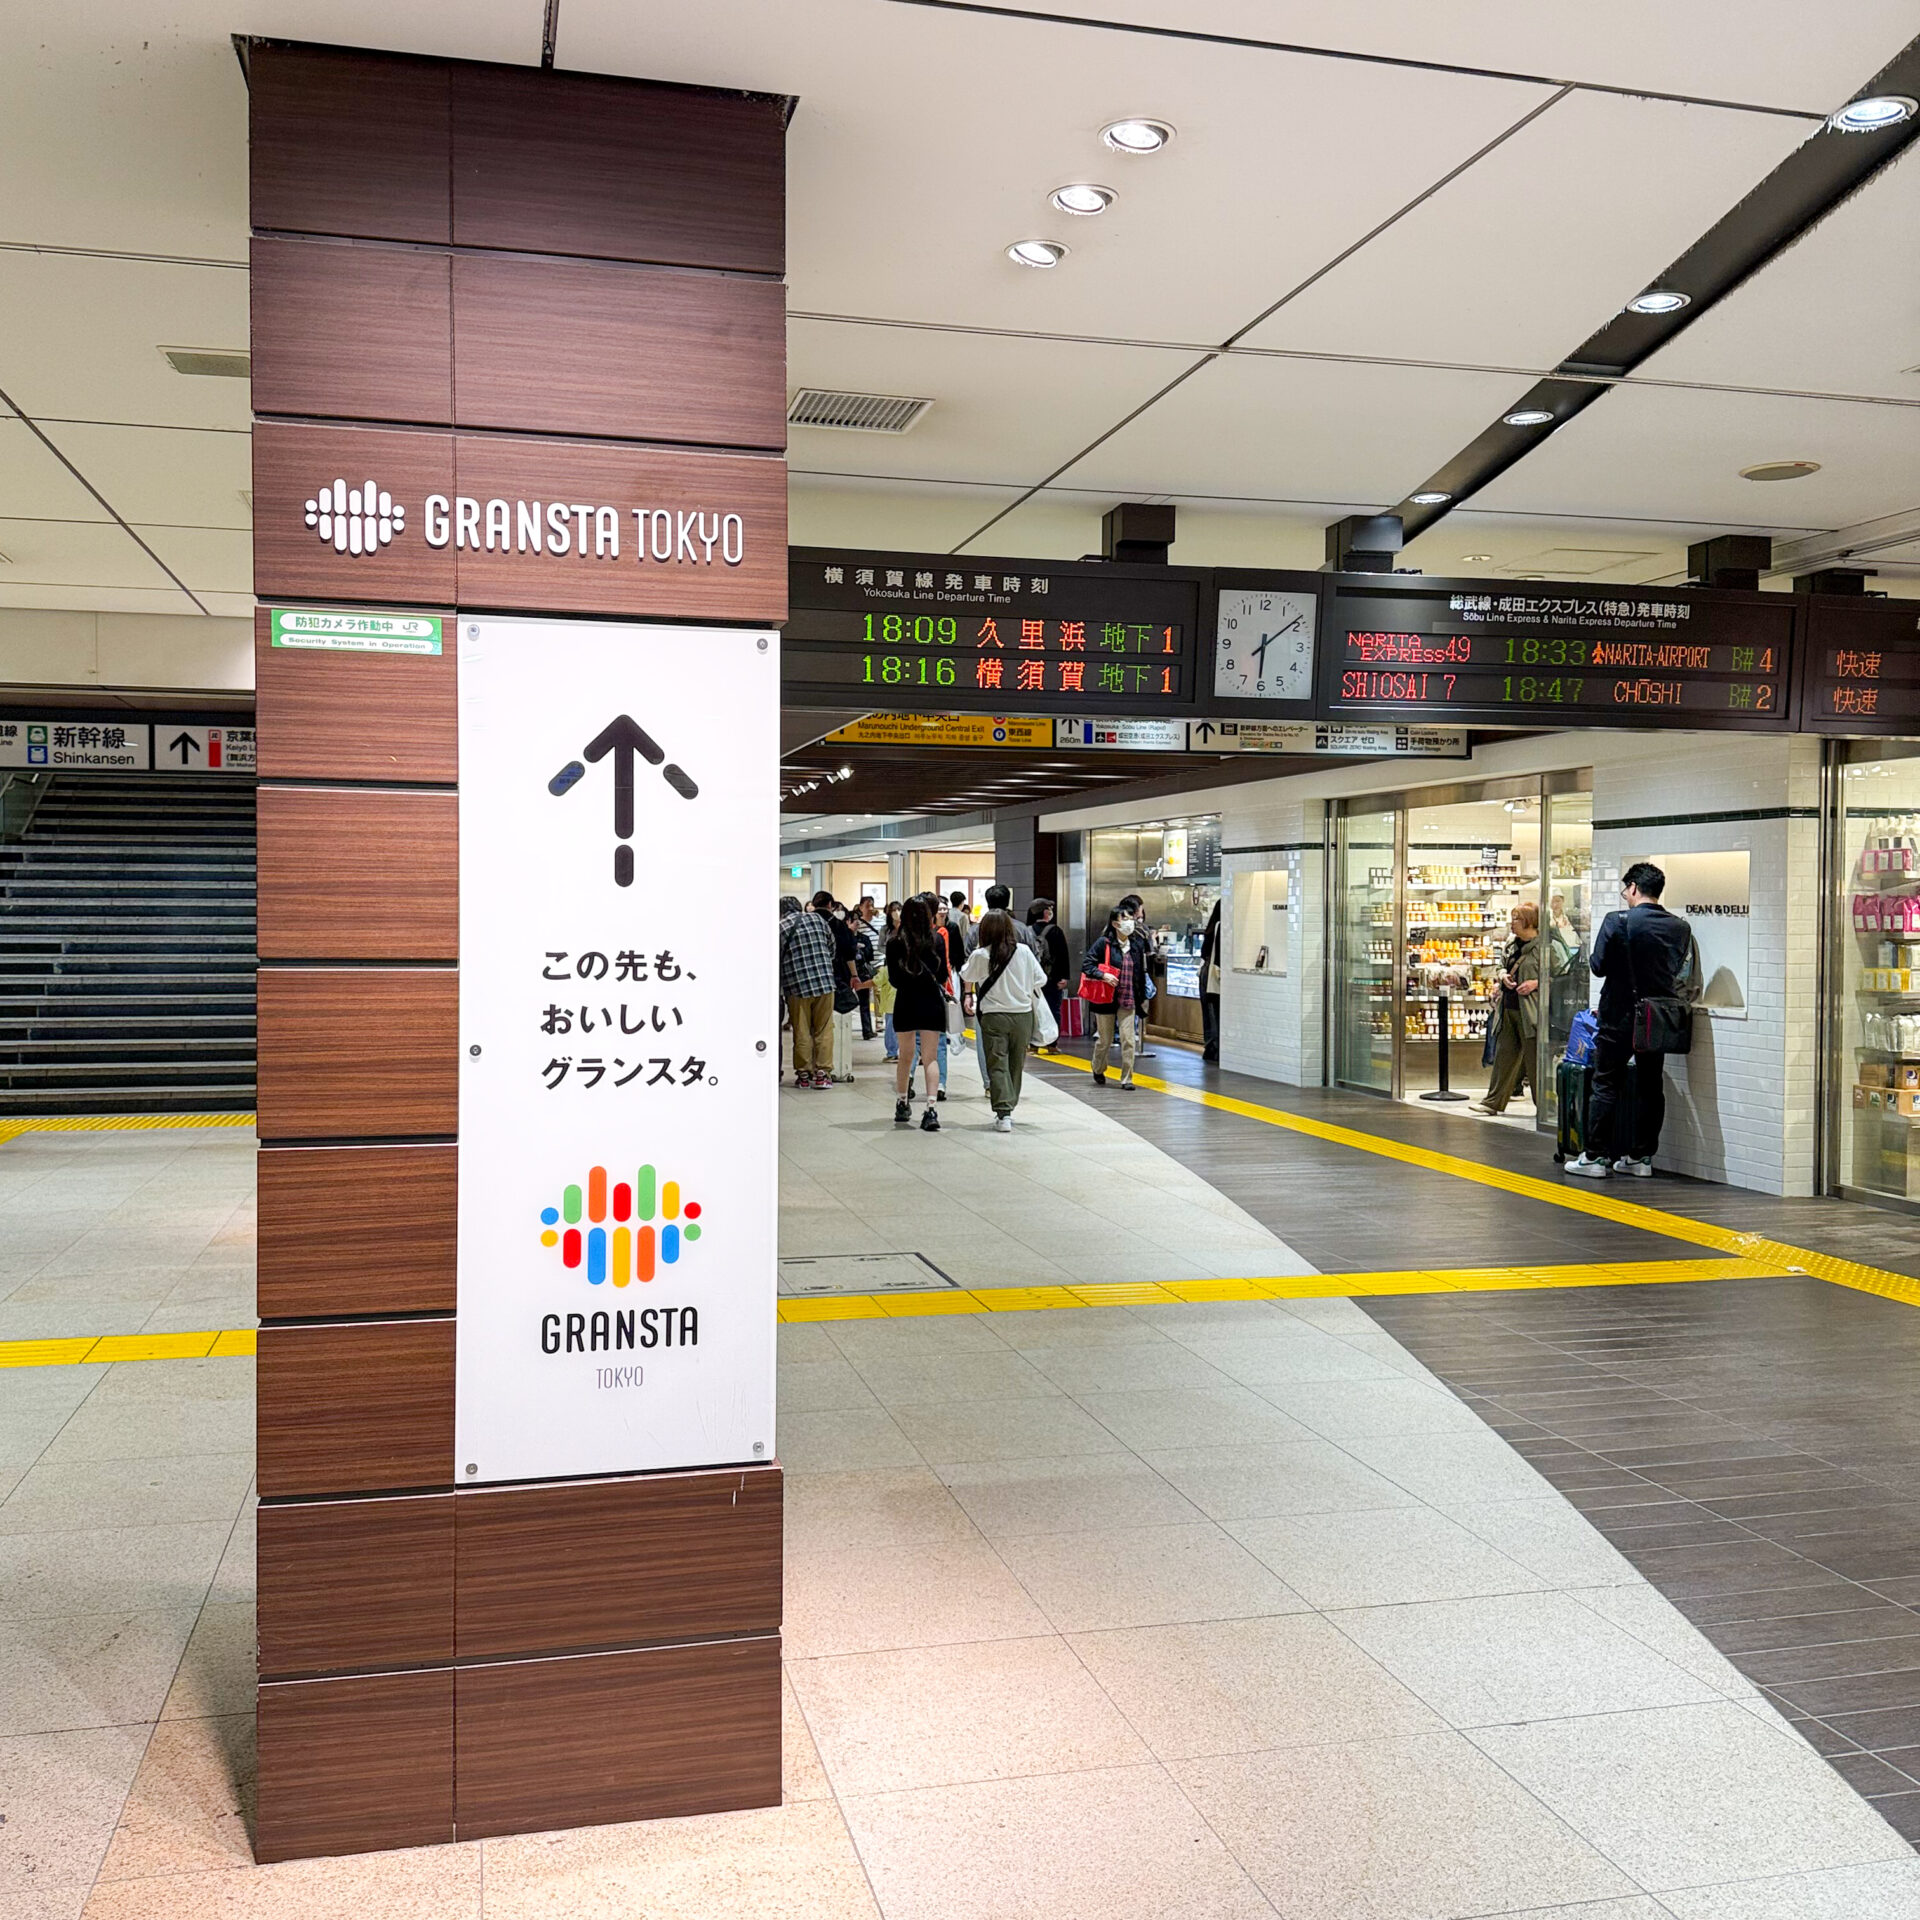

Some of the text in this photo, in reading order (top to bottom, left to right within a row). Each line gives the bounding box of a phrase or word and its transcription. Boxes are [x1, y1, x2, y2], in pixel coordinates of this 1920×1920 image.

[424, 494, 744, 564] GRANSTA TOKYO
[824, 566, 1049, 594] 横須賀線発車時刻
[863, 587, 1011, 604] Yokosuka Line Departure Time
[1243, 604, 1252, 615] 11
[1260, 599, 1272, 611] 12
[295, 616, 419, 632] 防犯カメラ作動中 JR
[1227, 618, 1238, 630] 10
[1292, 621, 1301, 632] 2
[1486, 612, 1505, 623] Line
[1507, 613, 1541, 625] Express
[1542, 614, 1549, 624] &
[1551, 615, 1577, 625] Narita
[1578, 616, 1612, 628] Express
[1614, 617, 1655, 629] Departure
[1657, 618, 1677, 630] Time
[863, 613, 1174, 654] 18:09 久里浜 地下 1
[1348, 632, 1422, 648] NARITA
[288, 636, 326, 645] Security
[331, 638, 364, 647] System
[382, 641, 426, 649] Operation
[1222, 638, 1231, 650] 9
[1296, 642, 1304, 653] 3
[1360, 647, 1446, 663] EXPRESS
[1446, 635, 1471, 663] 49
[1505, 638, 1586, 666] 18:33
[1759, 647, 1774, 673] 4
[1226, 659, 1235, 670] 8
[1289, 662, 1298, 672] 4
[1836, 649, 1882, 679] 快速
[862, 655, 1173, 693] 18:16 横須賀 地下 1
[1239, 674, 1248, 685] 7
[1276, 675, 1284, 687] 5
[1256, 680, 1266, 692] 6
[1341, 671, 1429, 699] SHIOSAI
[1443, 674, 1456, 700] 7
[1502, 676, 1584, 703] 18:47
[1613, 678, 1683, 704] CHŌSHI
[1756, 684, 1771, 710] 2
[1833, 686, 1879, 715] 快速
[858, 721, 984, 733] Marunouchi Underground Central Exit
[53, 726, 126, 749] 新幹線
[226, 730, 256, 743] 京葉
[1060, 736, 1081, 744] 260m
[1330, 736, 1375, 744] スクエア ゼロ
[53, 751, 135, 765] Shinkansen
[1685, 904, 1713, 914] DEAN
[1714, 904, 1722, 914] &
[542, 950, 697, 982] この先も、
[540, 1003, 684, 1035] おいしい
[541, 1055, 719, 1090] グランスタ。
[541, 1306, 699, 1355] GRANSTA
[596, 1365, 644, 1390] TOKYO
